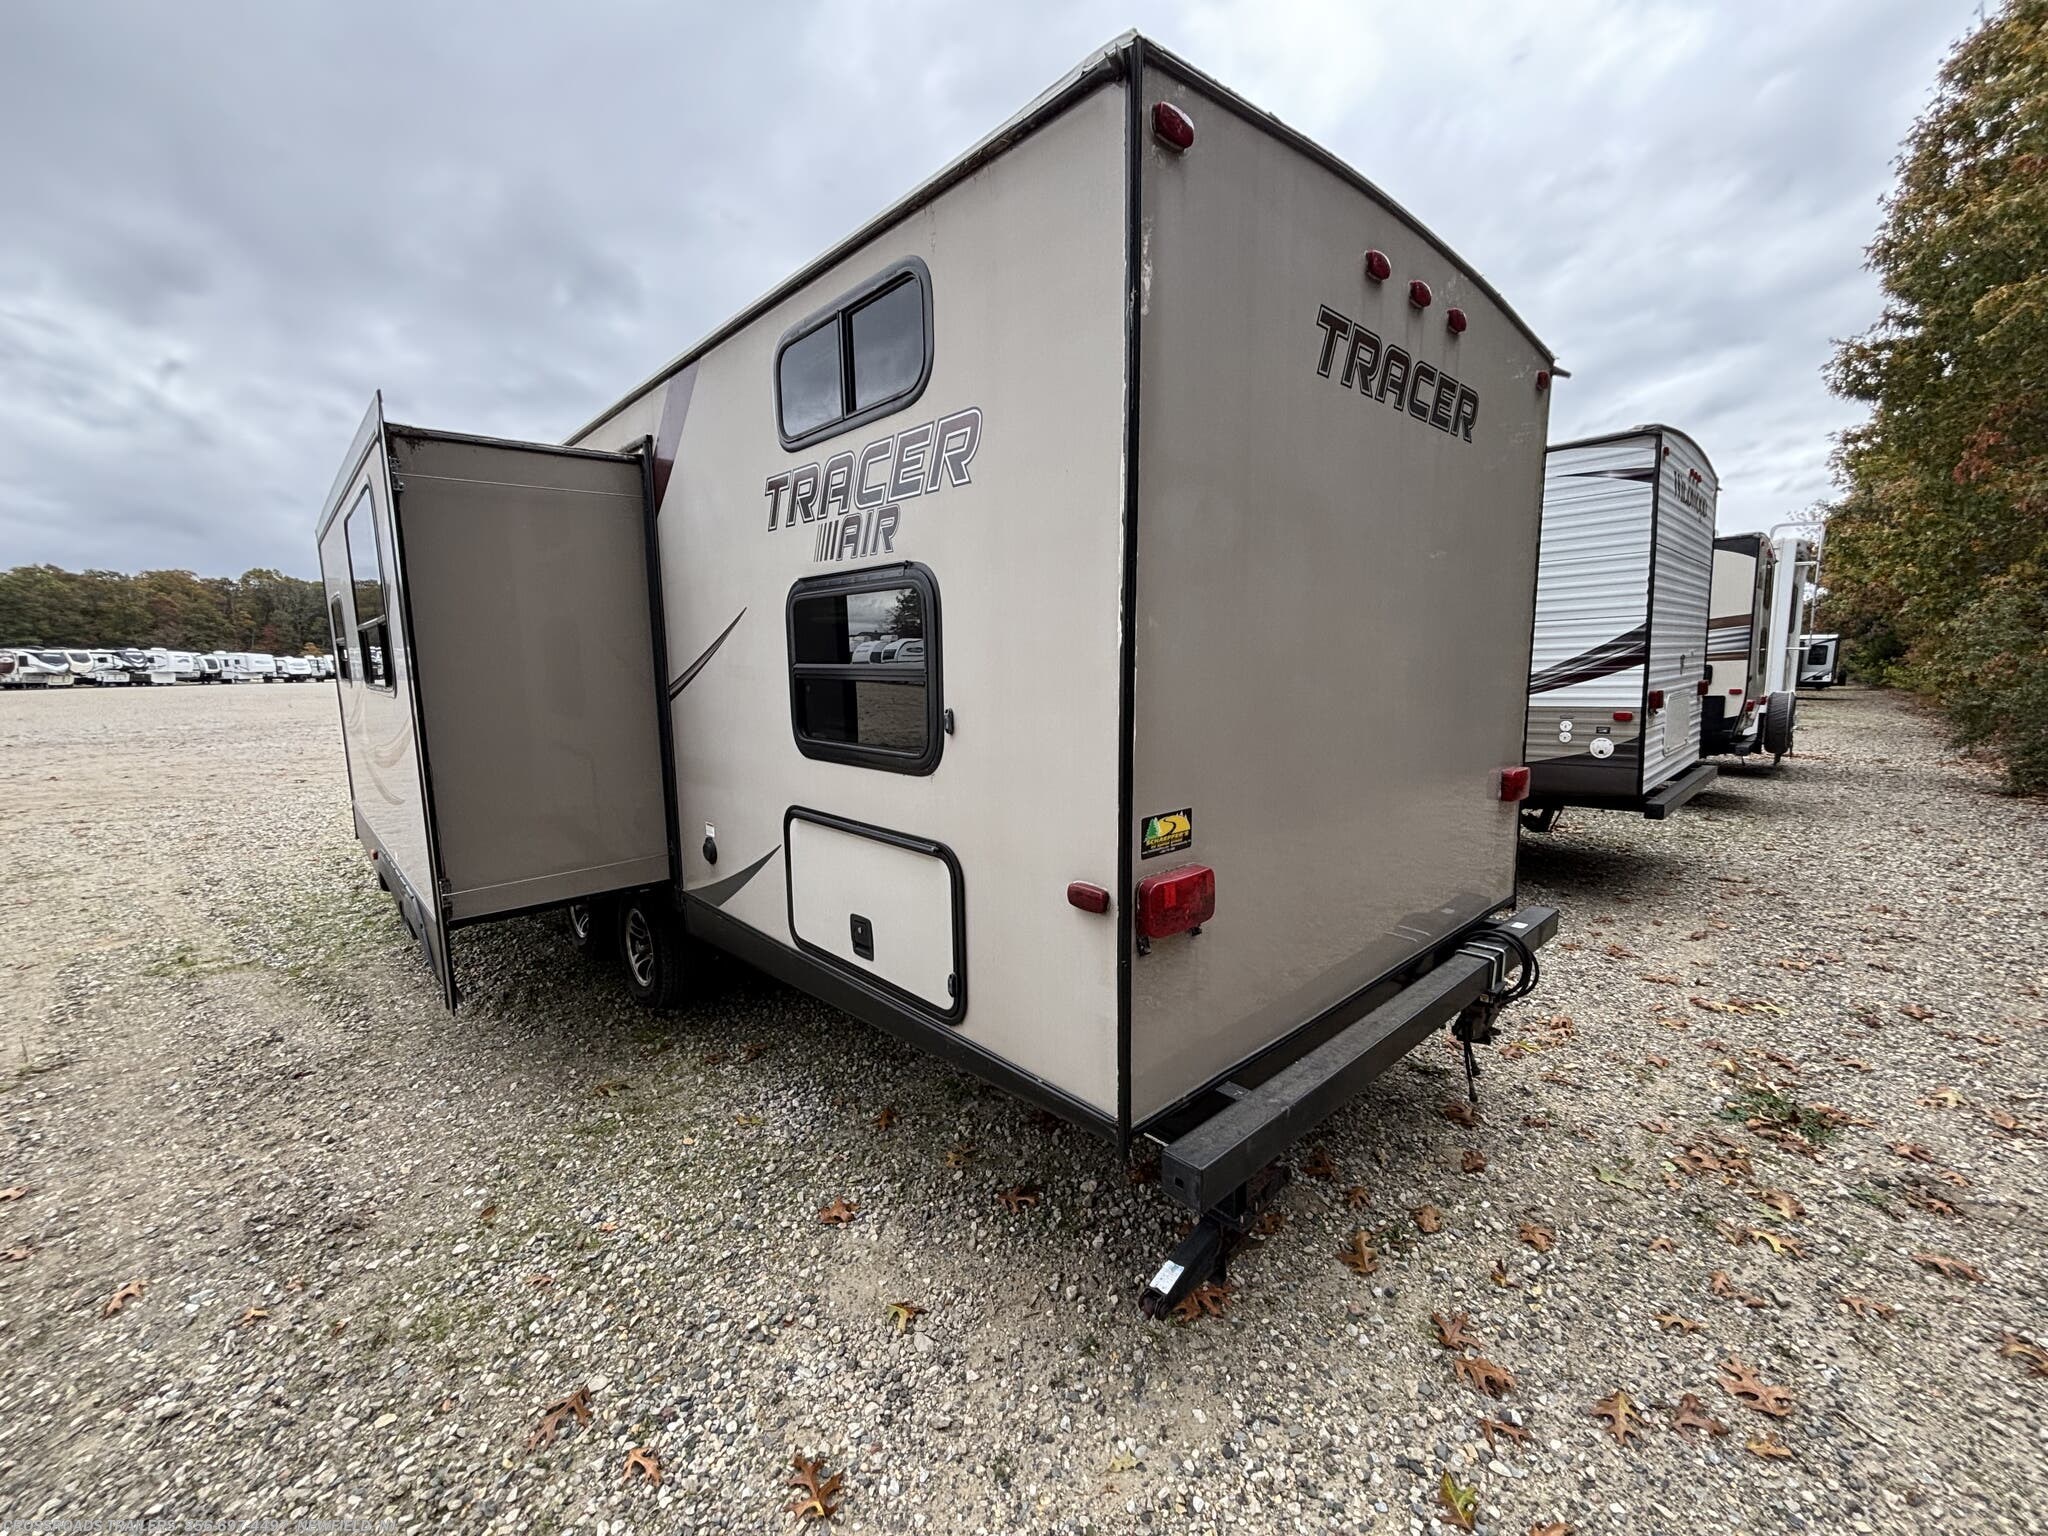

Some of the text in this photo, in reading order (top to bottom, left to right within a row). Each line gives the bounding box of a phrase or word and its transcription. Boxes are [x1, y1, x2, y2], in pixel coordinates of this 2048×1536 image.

[1316, 304, 1480, 444] TRACER
[764, 406, 983, 532] TRACER
[836, 503, 901, 561] AIR
